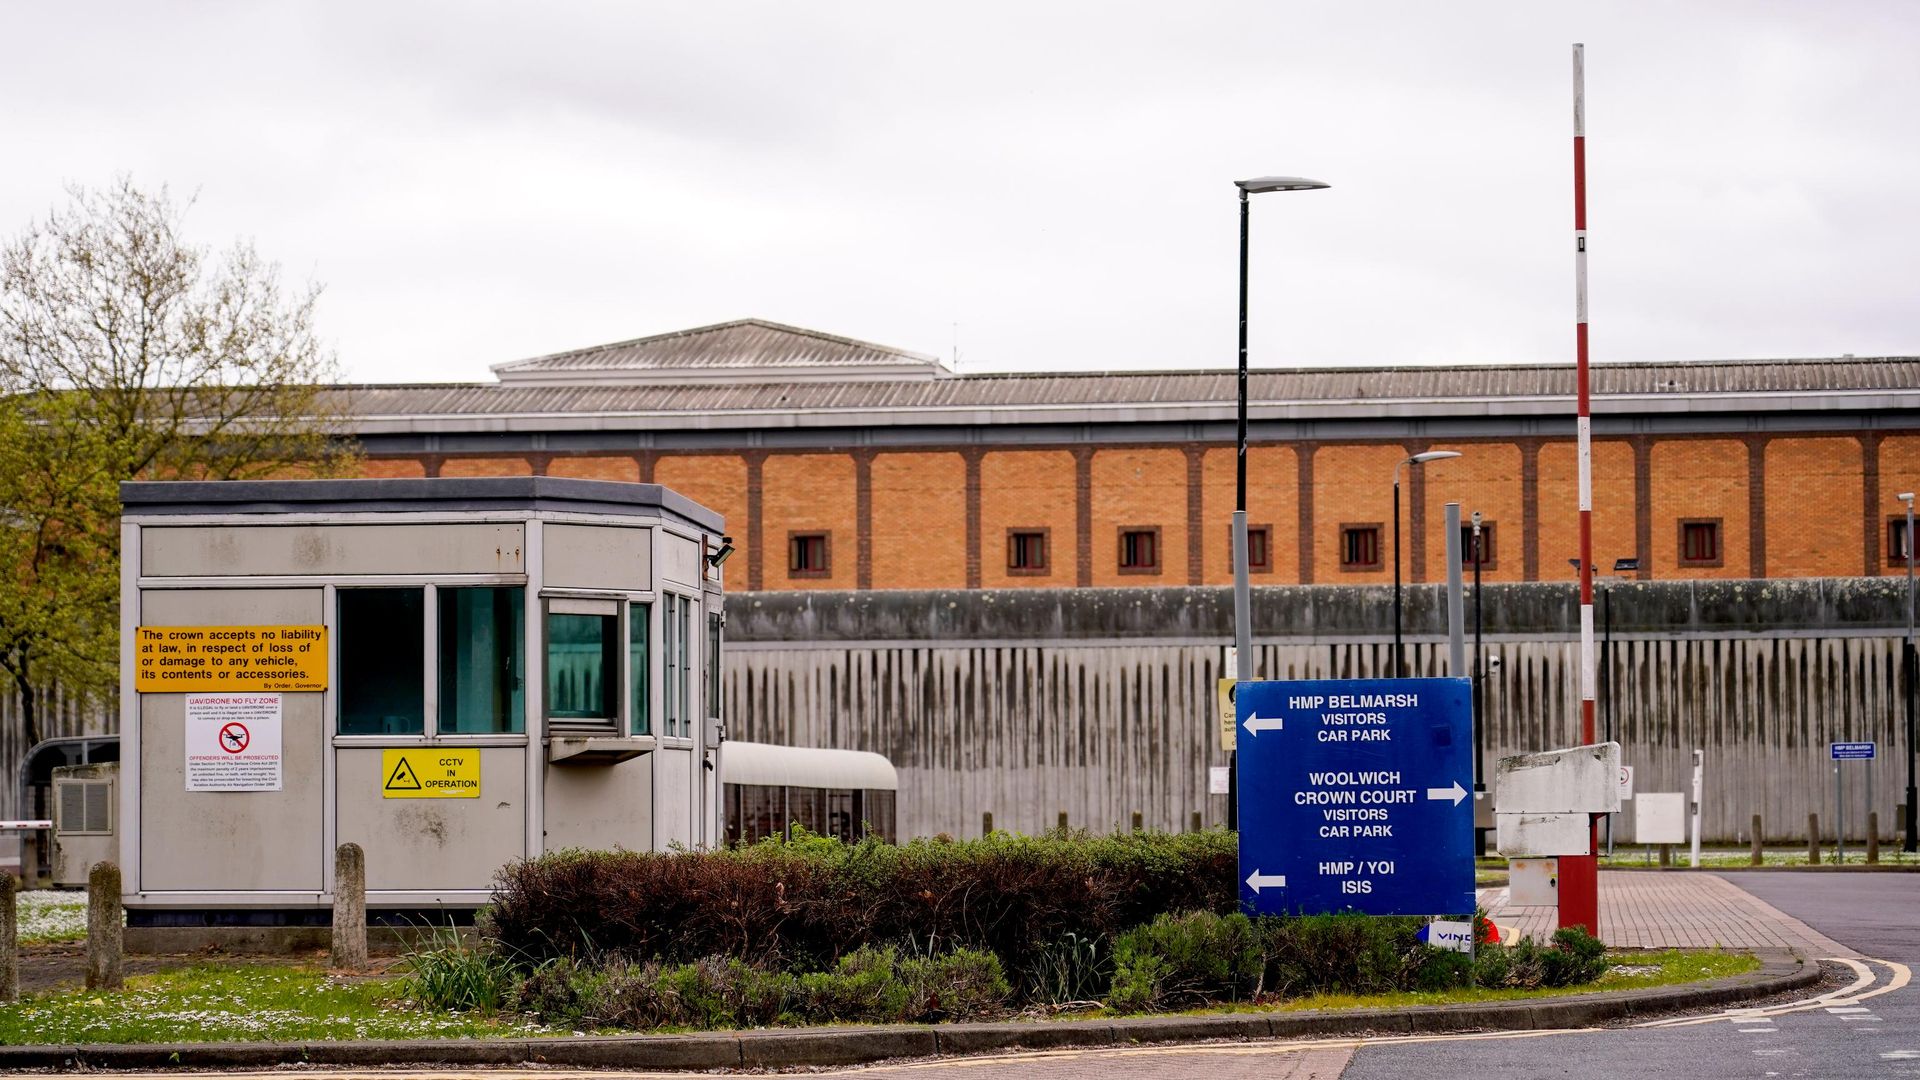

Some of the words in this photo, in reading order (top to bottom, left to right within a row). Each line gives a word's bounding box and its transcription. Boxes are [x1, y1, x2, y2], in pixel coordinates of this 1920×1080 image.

[142, 630, 163, 640] The
[168, 632, 204, 640] crown
[209, 630, 256, 641] accepts
[281, 630, 322, 640] liability
[142, 644, 152, 653] at
[159, 644, 181, 654] law,
[187, 643, 196, 652] in
[202, 644, 246, 654] respect
[252, 643, 264, 652] of
[269, 643, 293, 652] loss
[299, 643, 311, 652] of
[142, 658, 154, 666] or
[159, 656, 205, 668] damage
[211, 657, 223, 666] to
[228, 658, 249, 667] any
[255, 656, 298, 667] vehicle,
[141, 670, 156, 679] its
[162, 670, 212, 679] contents
[218, 671, 230, 679] or
[235, 669, 309, 679] accessories.
[1289, 696, 1324, 709] HMP
[1328, 694, 1418, 708] BELMARSH
[1322, 712, 1386, 725] VISITORS
[1318, 730, 1348, 742] CAR
[1352, 729, 1391, 741] PARK
[1309, 771, 1401, 785] WOOLWICH
[1294, 791, 1356, 805] CROWN
[1360, 790, 1416, 804] COURT
[1323, 808, 1388, 821] VISITORS
[1319, 826, 1349, 838] CAR
[1353, 825, 1393, 837] PARK
[1319, 862, 1354, 875] HMP
[1358, 862, 1364, 874] /
[1367, 861, 1394, 874] YOI
[1342, 880, 1372, 894] ISIS
